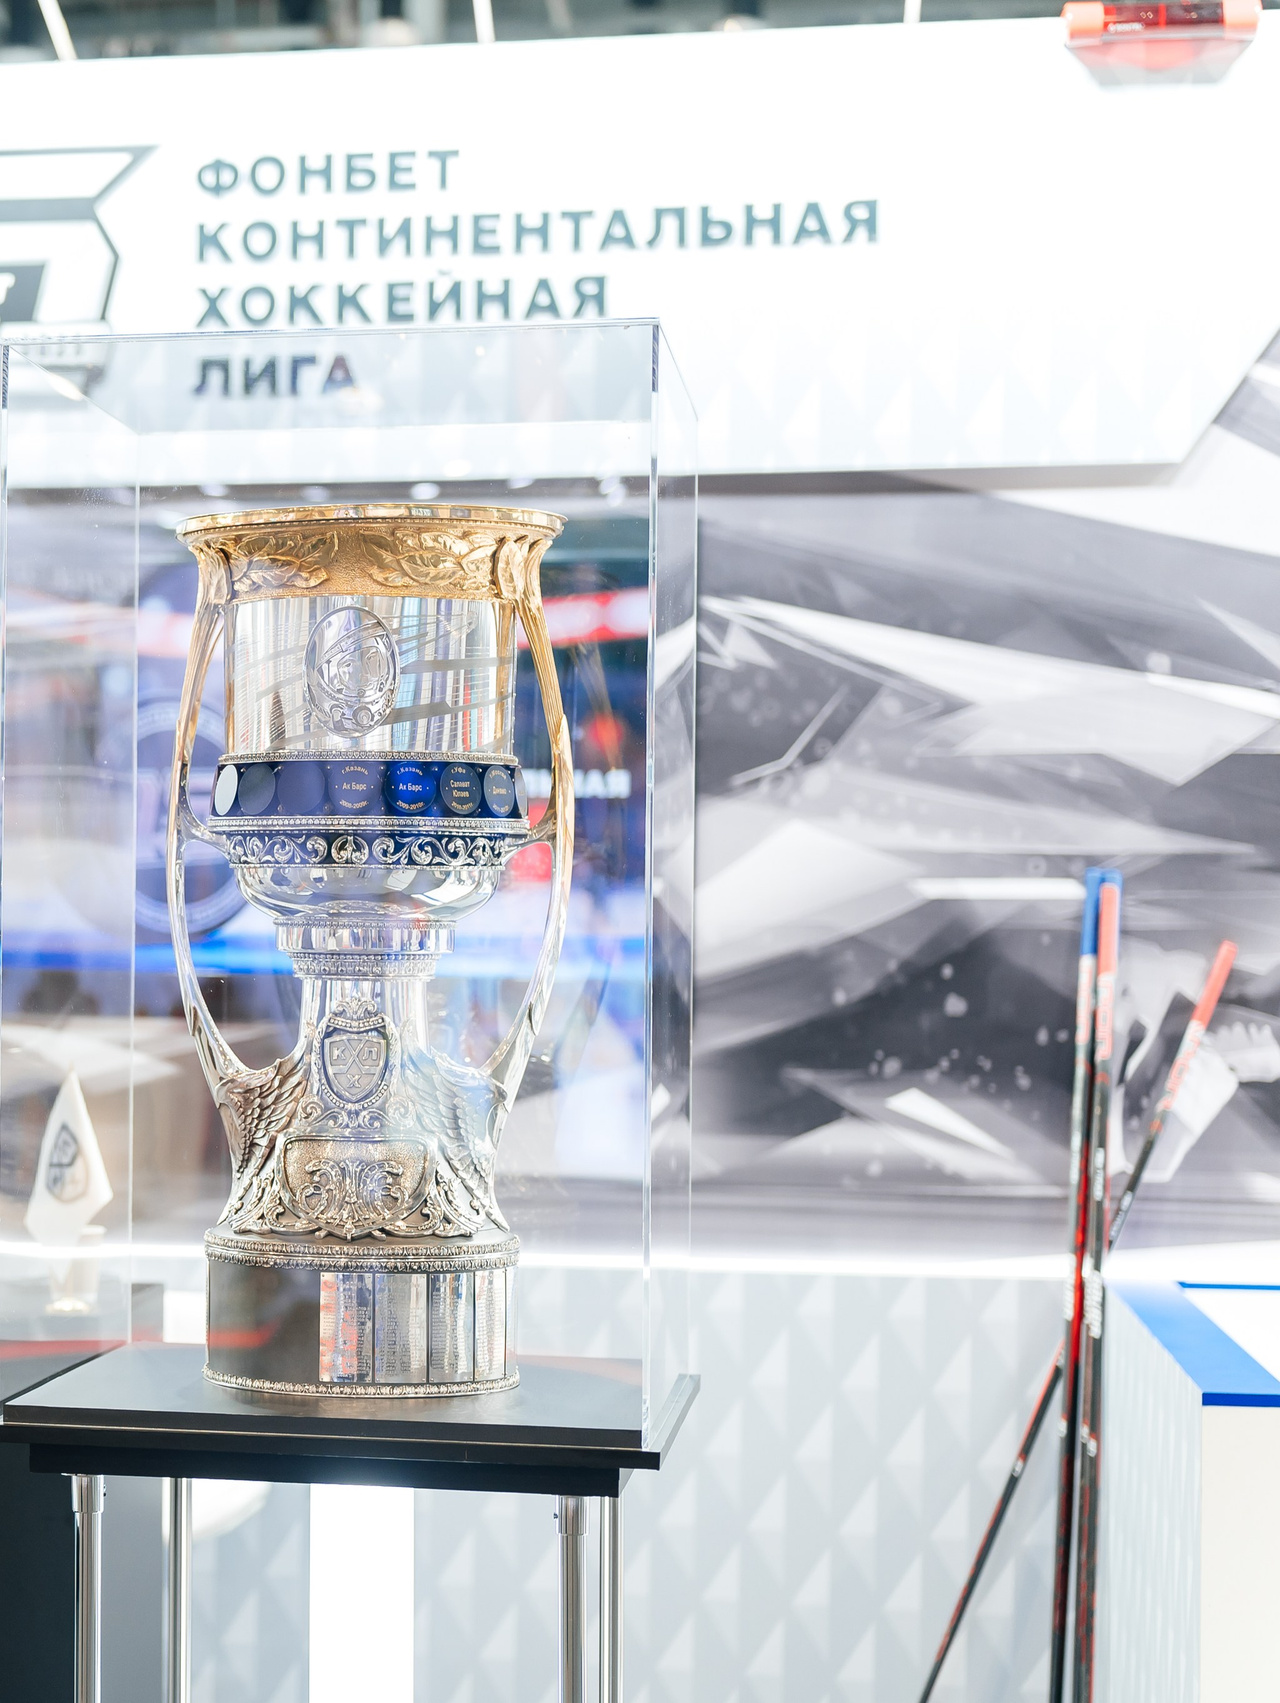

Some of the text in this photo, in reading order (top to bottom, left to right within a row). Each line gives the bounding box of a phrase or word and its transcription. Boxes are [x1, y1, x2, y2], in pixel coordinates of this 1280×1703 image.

[195, 149, 460, 198] ФОНБЕТ
[195, 199, 879, 264] КОНТИНЕНТАЛЬНАЯ
[194, 269, 608, 329] ХОККЕЙНАЯ
[191, 354, 358, 400] ЛИГА
[342, 782, 367, 791] Ак Барс
[398, 783, 423, 792] Ак Барс
